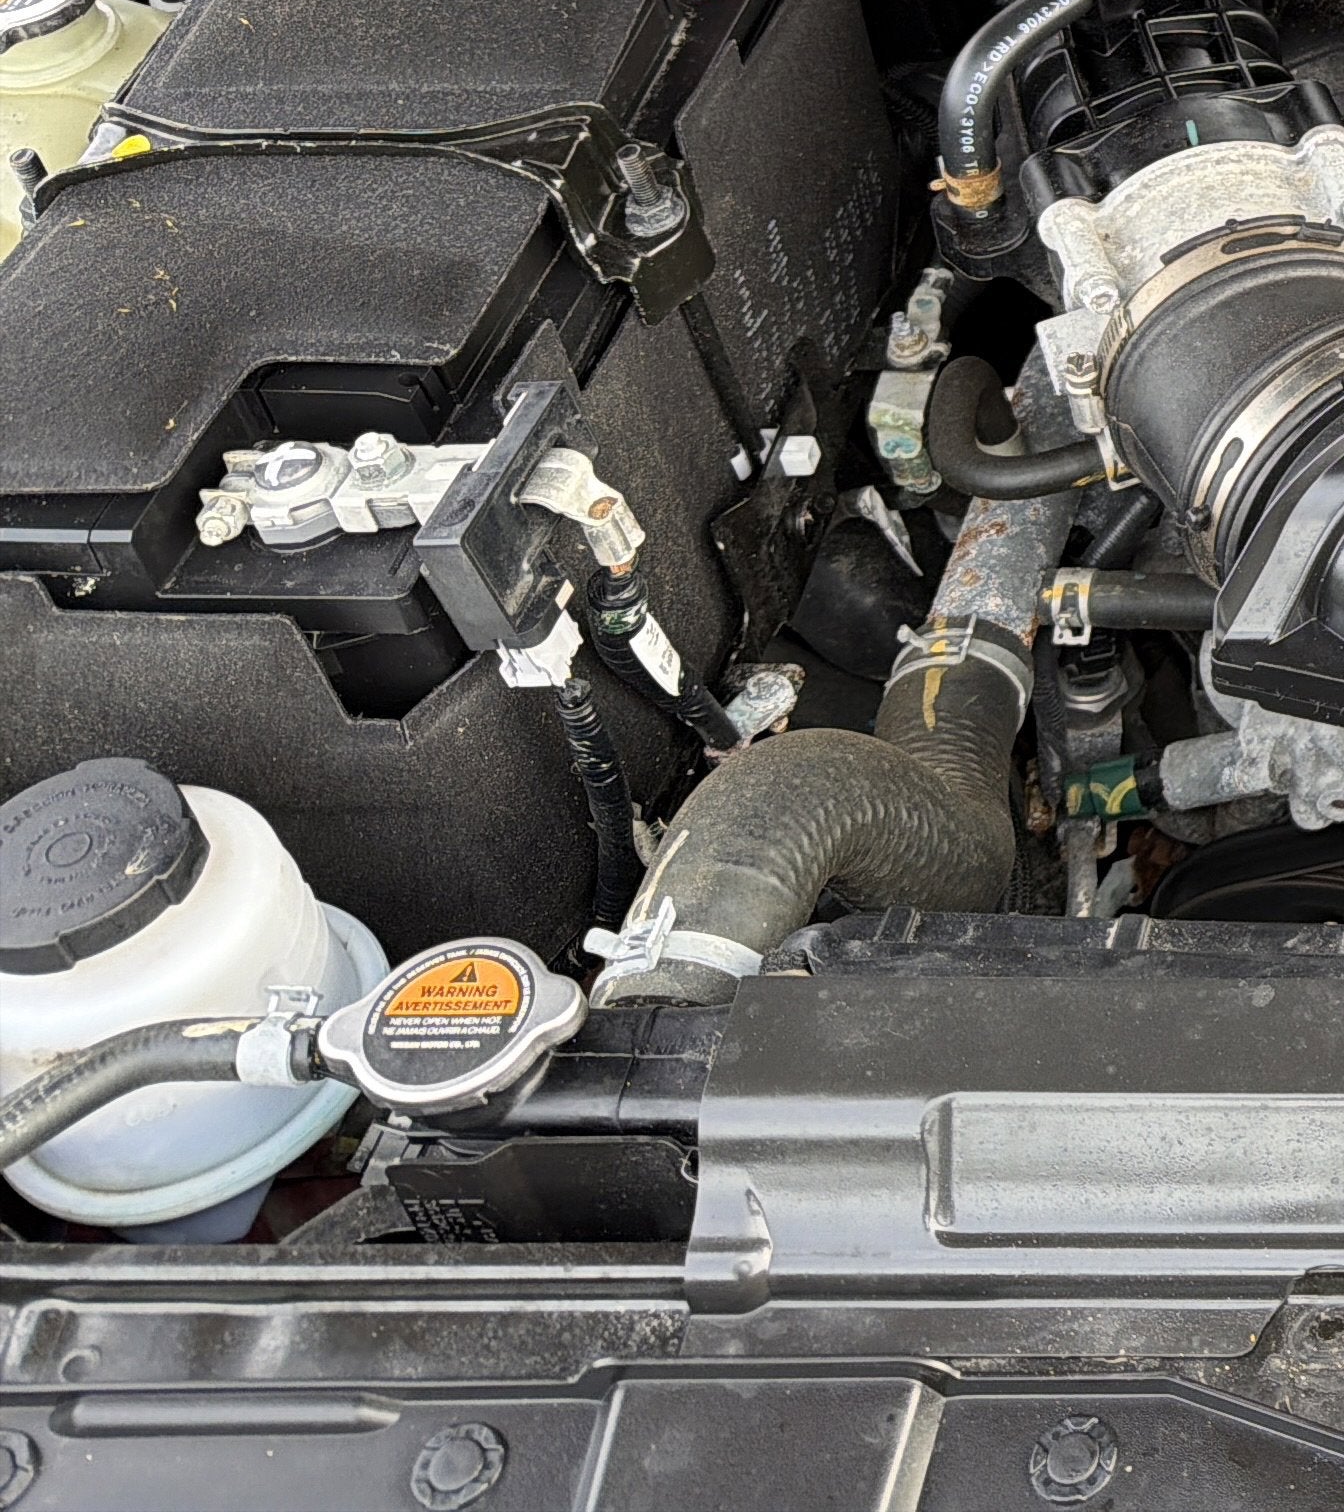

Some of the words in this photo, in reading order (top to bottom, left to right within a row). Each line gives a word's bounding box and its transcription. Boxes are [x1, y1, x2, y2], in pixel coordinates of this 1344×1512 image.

[420, 984, 498, 998] WARNING
[394, 999, 512, 1012] AVERTISSEMENT
[389, 1016, 421, 1025] NEVER
[422, 1016, 449, 1025] OPEN
[451, 1016, 479, 1025] WHEN
